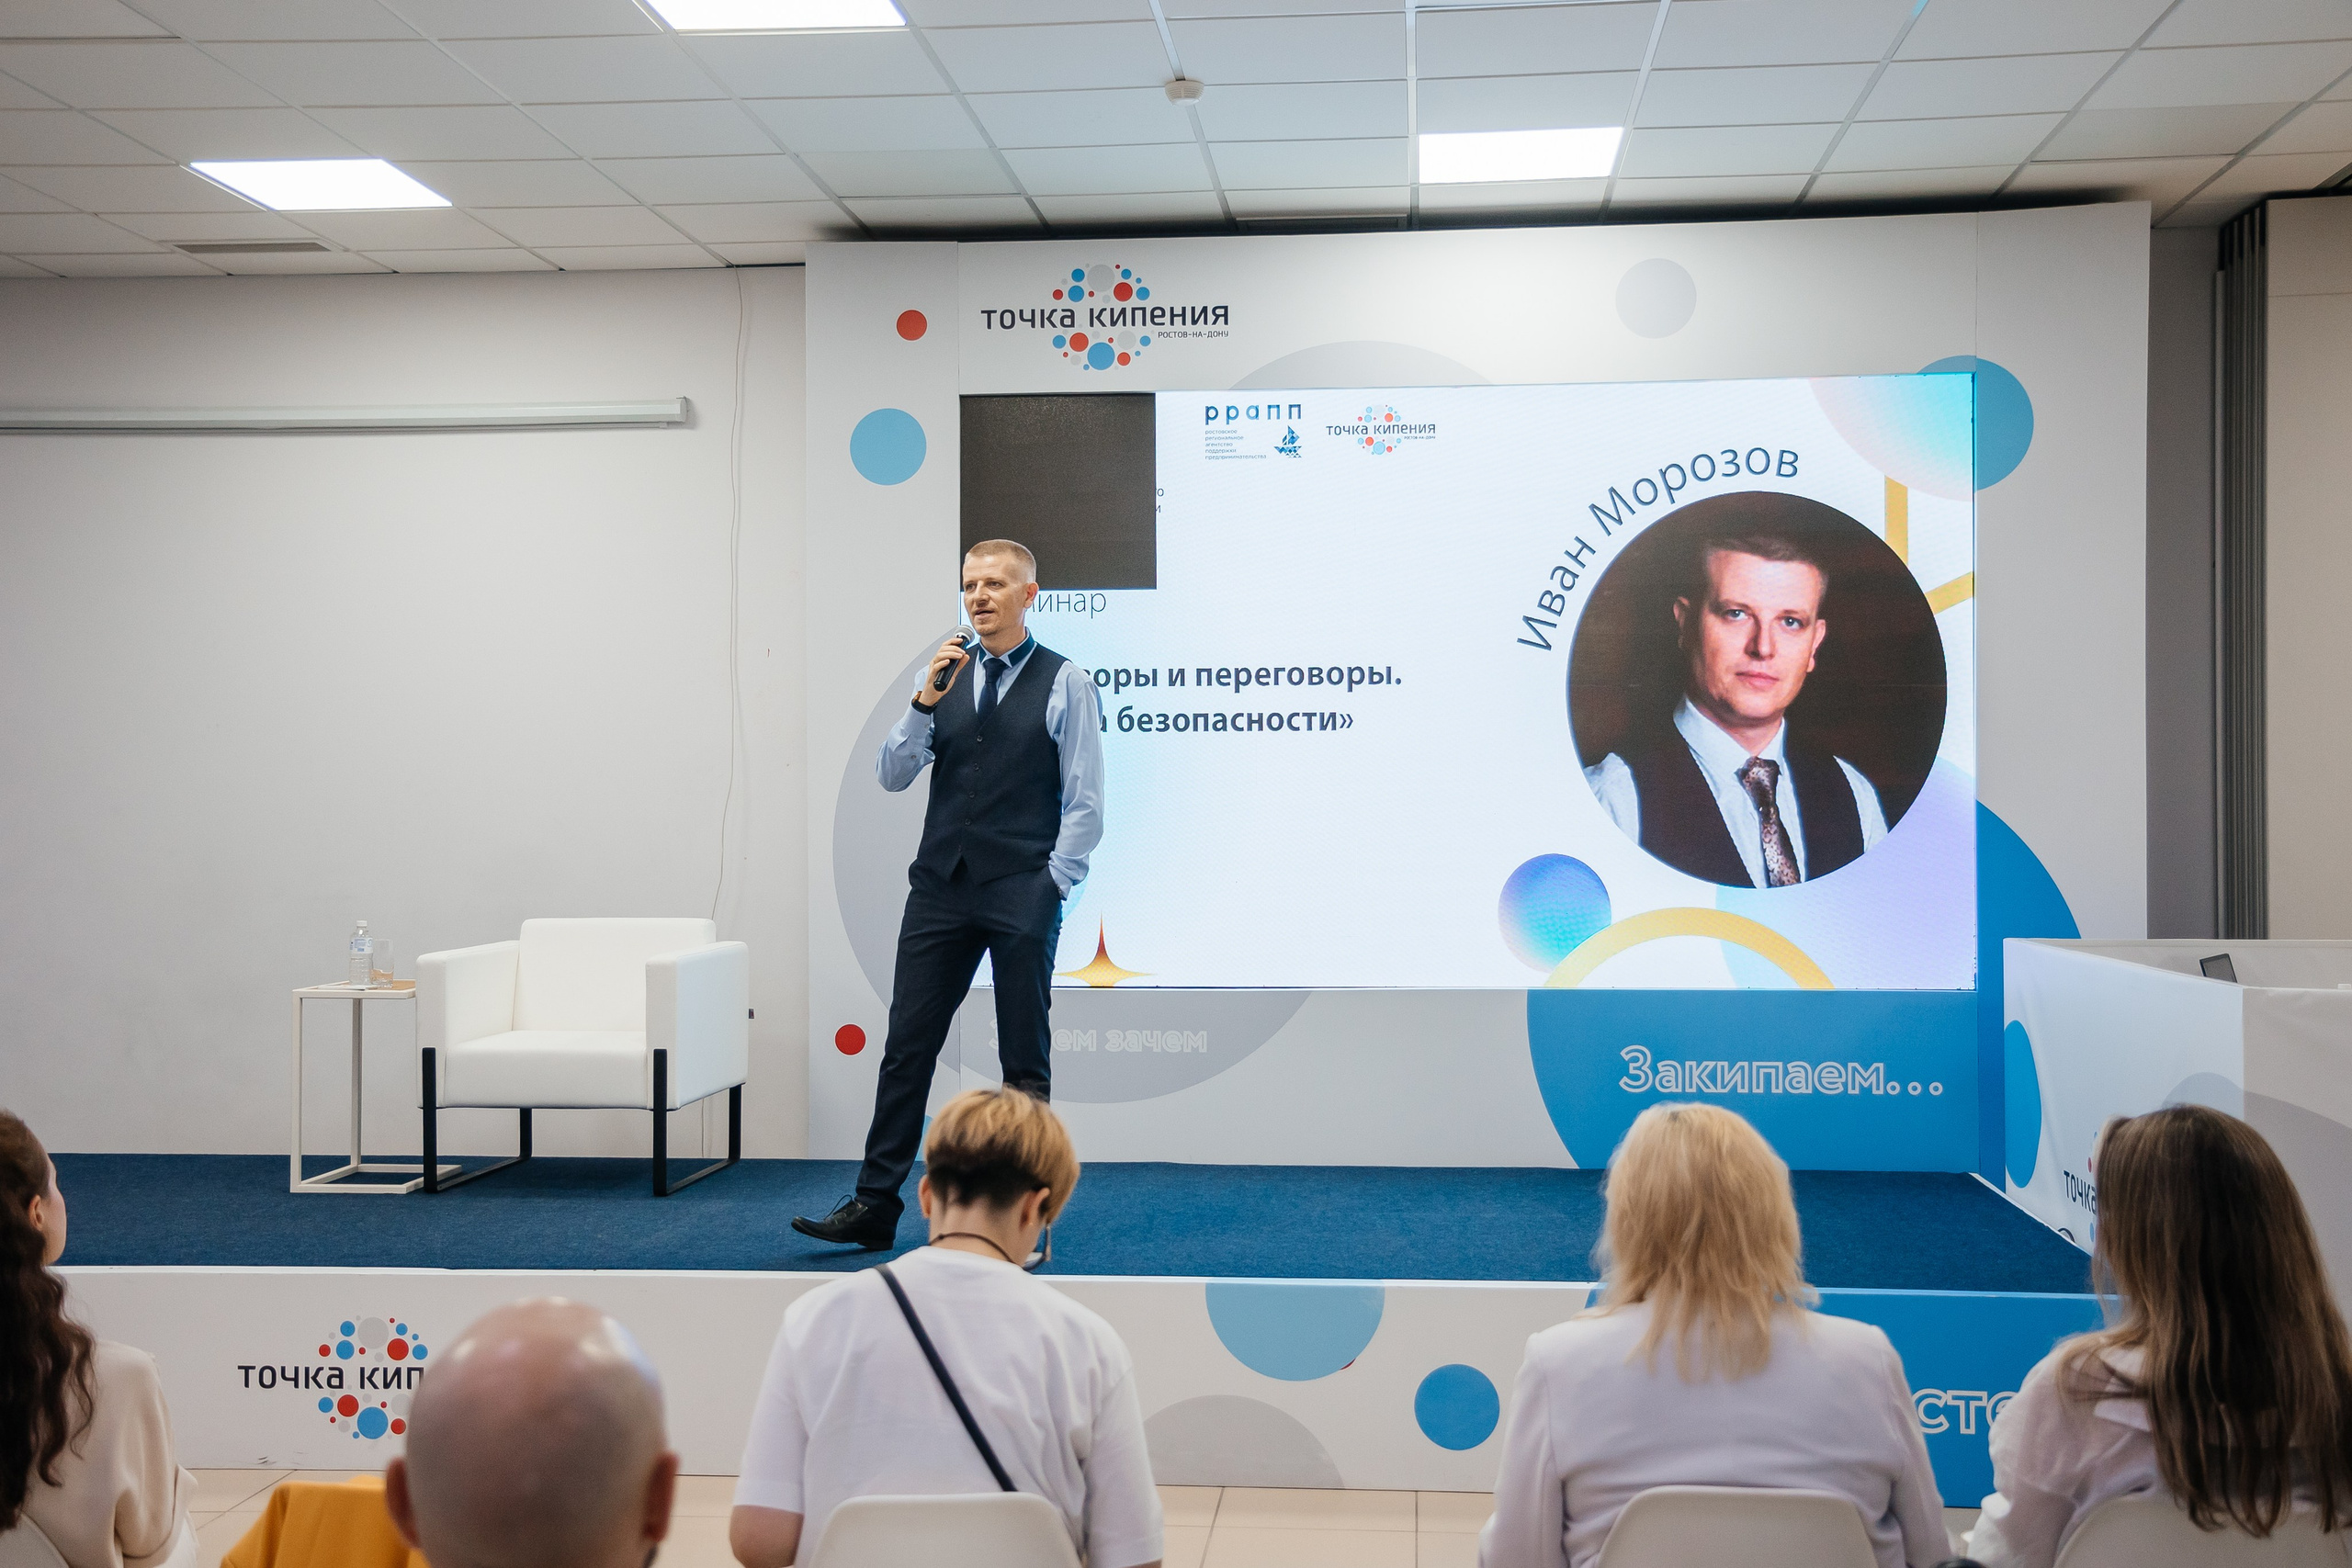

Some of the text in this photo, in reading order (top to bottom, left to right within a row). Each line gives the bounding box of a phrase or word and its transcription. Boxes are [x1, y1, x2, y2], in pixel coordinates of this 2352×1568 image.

[1089, 305, 1230, 328] кипения
[1374, 423, 1436, 434] кипения
[1589, 446, 1799, 536] Морозов
[1517, 536, 1597, 651] Иван
[1083, 665, 1403, 694] оры и переговоры.
[1116, 705, 1353, 733] безопасности»
[1619, 1044, 1943, 1096] Закипаем...
[359, 1366, 424, 1390] кип
